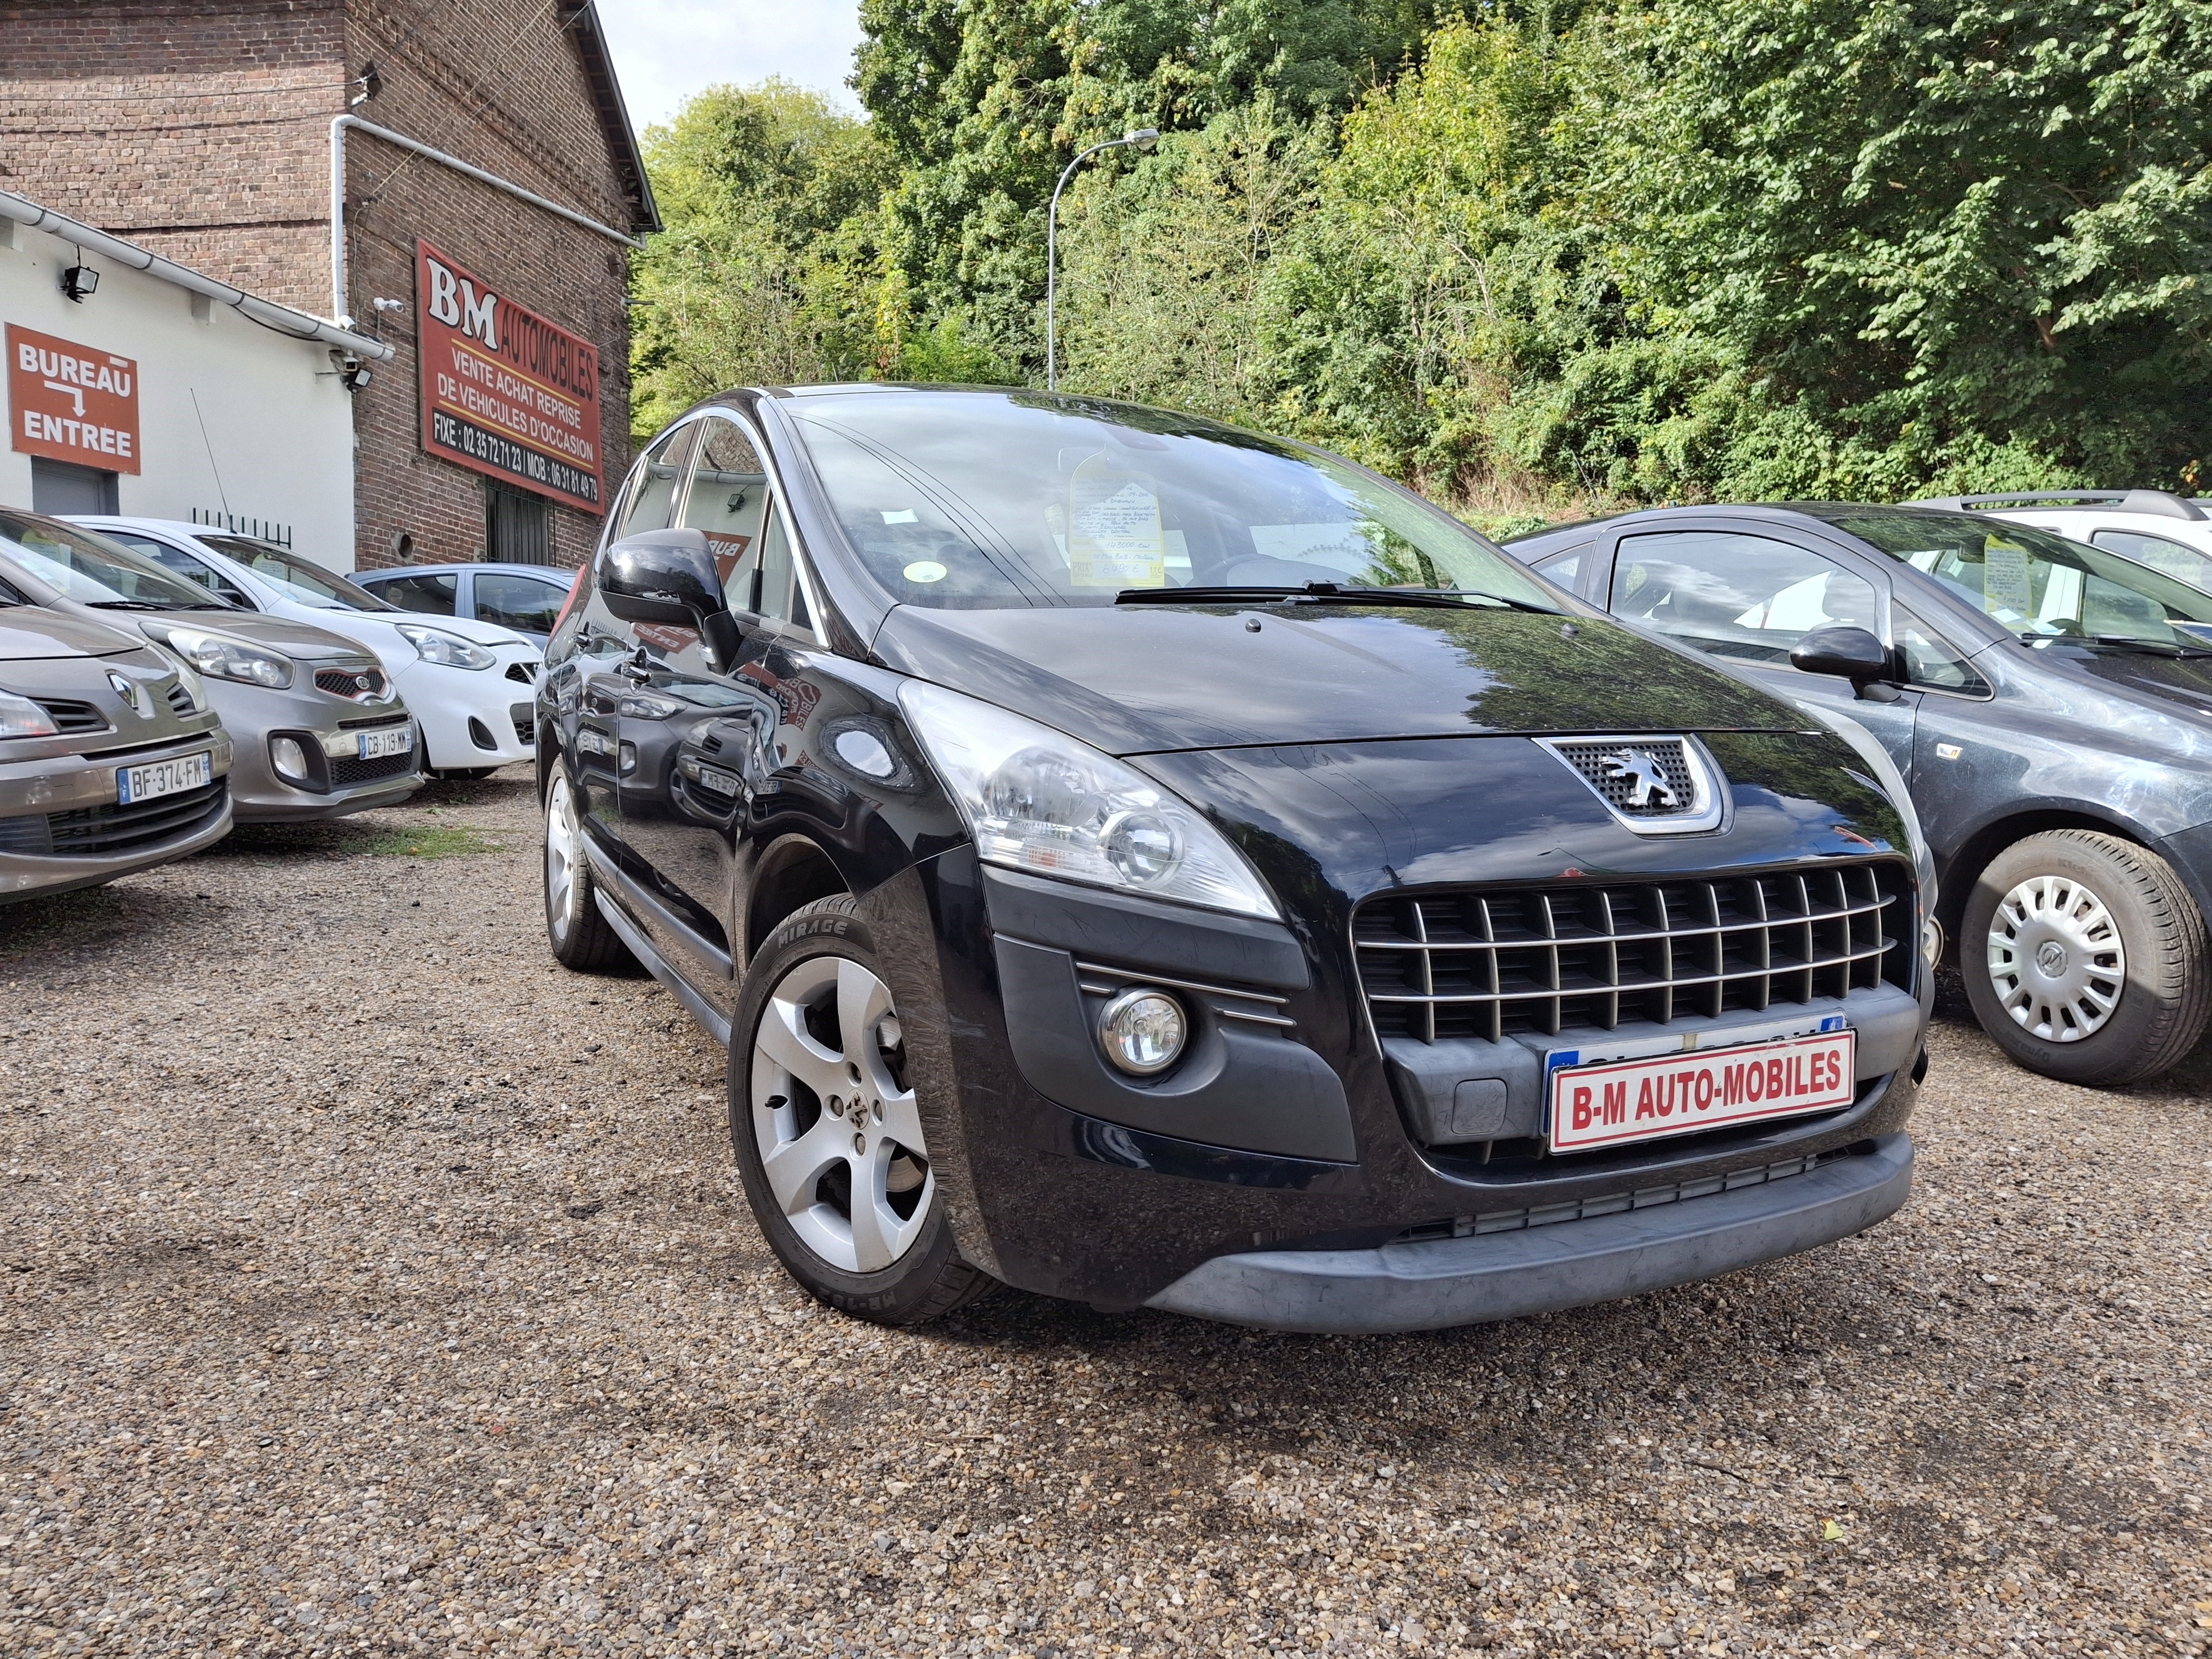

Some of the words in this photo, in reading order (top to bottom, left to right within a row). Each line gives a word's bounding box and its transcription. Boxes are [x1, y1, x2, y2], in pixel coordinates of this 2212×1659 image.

[426, 255, 498, 351] BM
[500, 304, 593, 402] AUTOMOBILES
[18, 343, 131, 397] BUREAU
[452, 347, 494, 389] VENTE
[496, 371, 538, 408] ACHAT
[537, 391, 582, 430] REPRISE
[24, 410, 132, 458] ENTREE
[433, 412, 456, 447] FIXE
[464, 425, 475, 454] 02
[477, 429, 487, 459] 35
[488, 435, 499, 464] 72
[500, 441, 510, 468] 71
[511, 445, 522, 473] 23
[527, 452, 546, 481] MOB
[551, 462, 561, 487] 06
[561, 466, 569, 491] 31
[571, 470, 580, 494] 81
[581, 474, 589, 497] 49
[590, 478, 598, 501] 79
[438, 372, 457, 402] DE
[459, 382, 528, 433] VEHICULES
[530, 415, 594, 462] D'OCCASION
[1102, 563, 1129, 574] 6490
[778, 919, 848, 949] MIRAGE
[1572, 1081, 1626, 1130] B-M
[1635, 1050, 1841, 1121] AUTO-MOBILES
